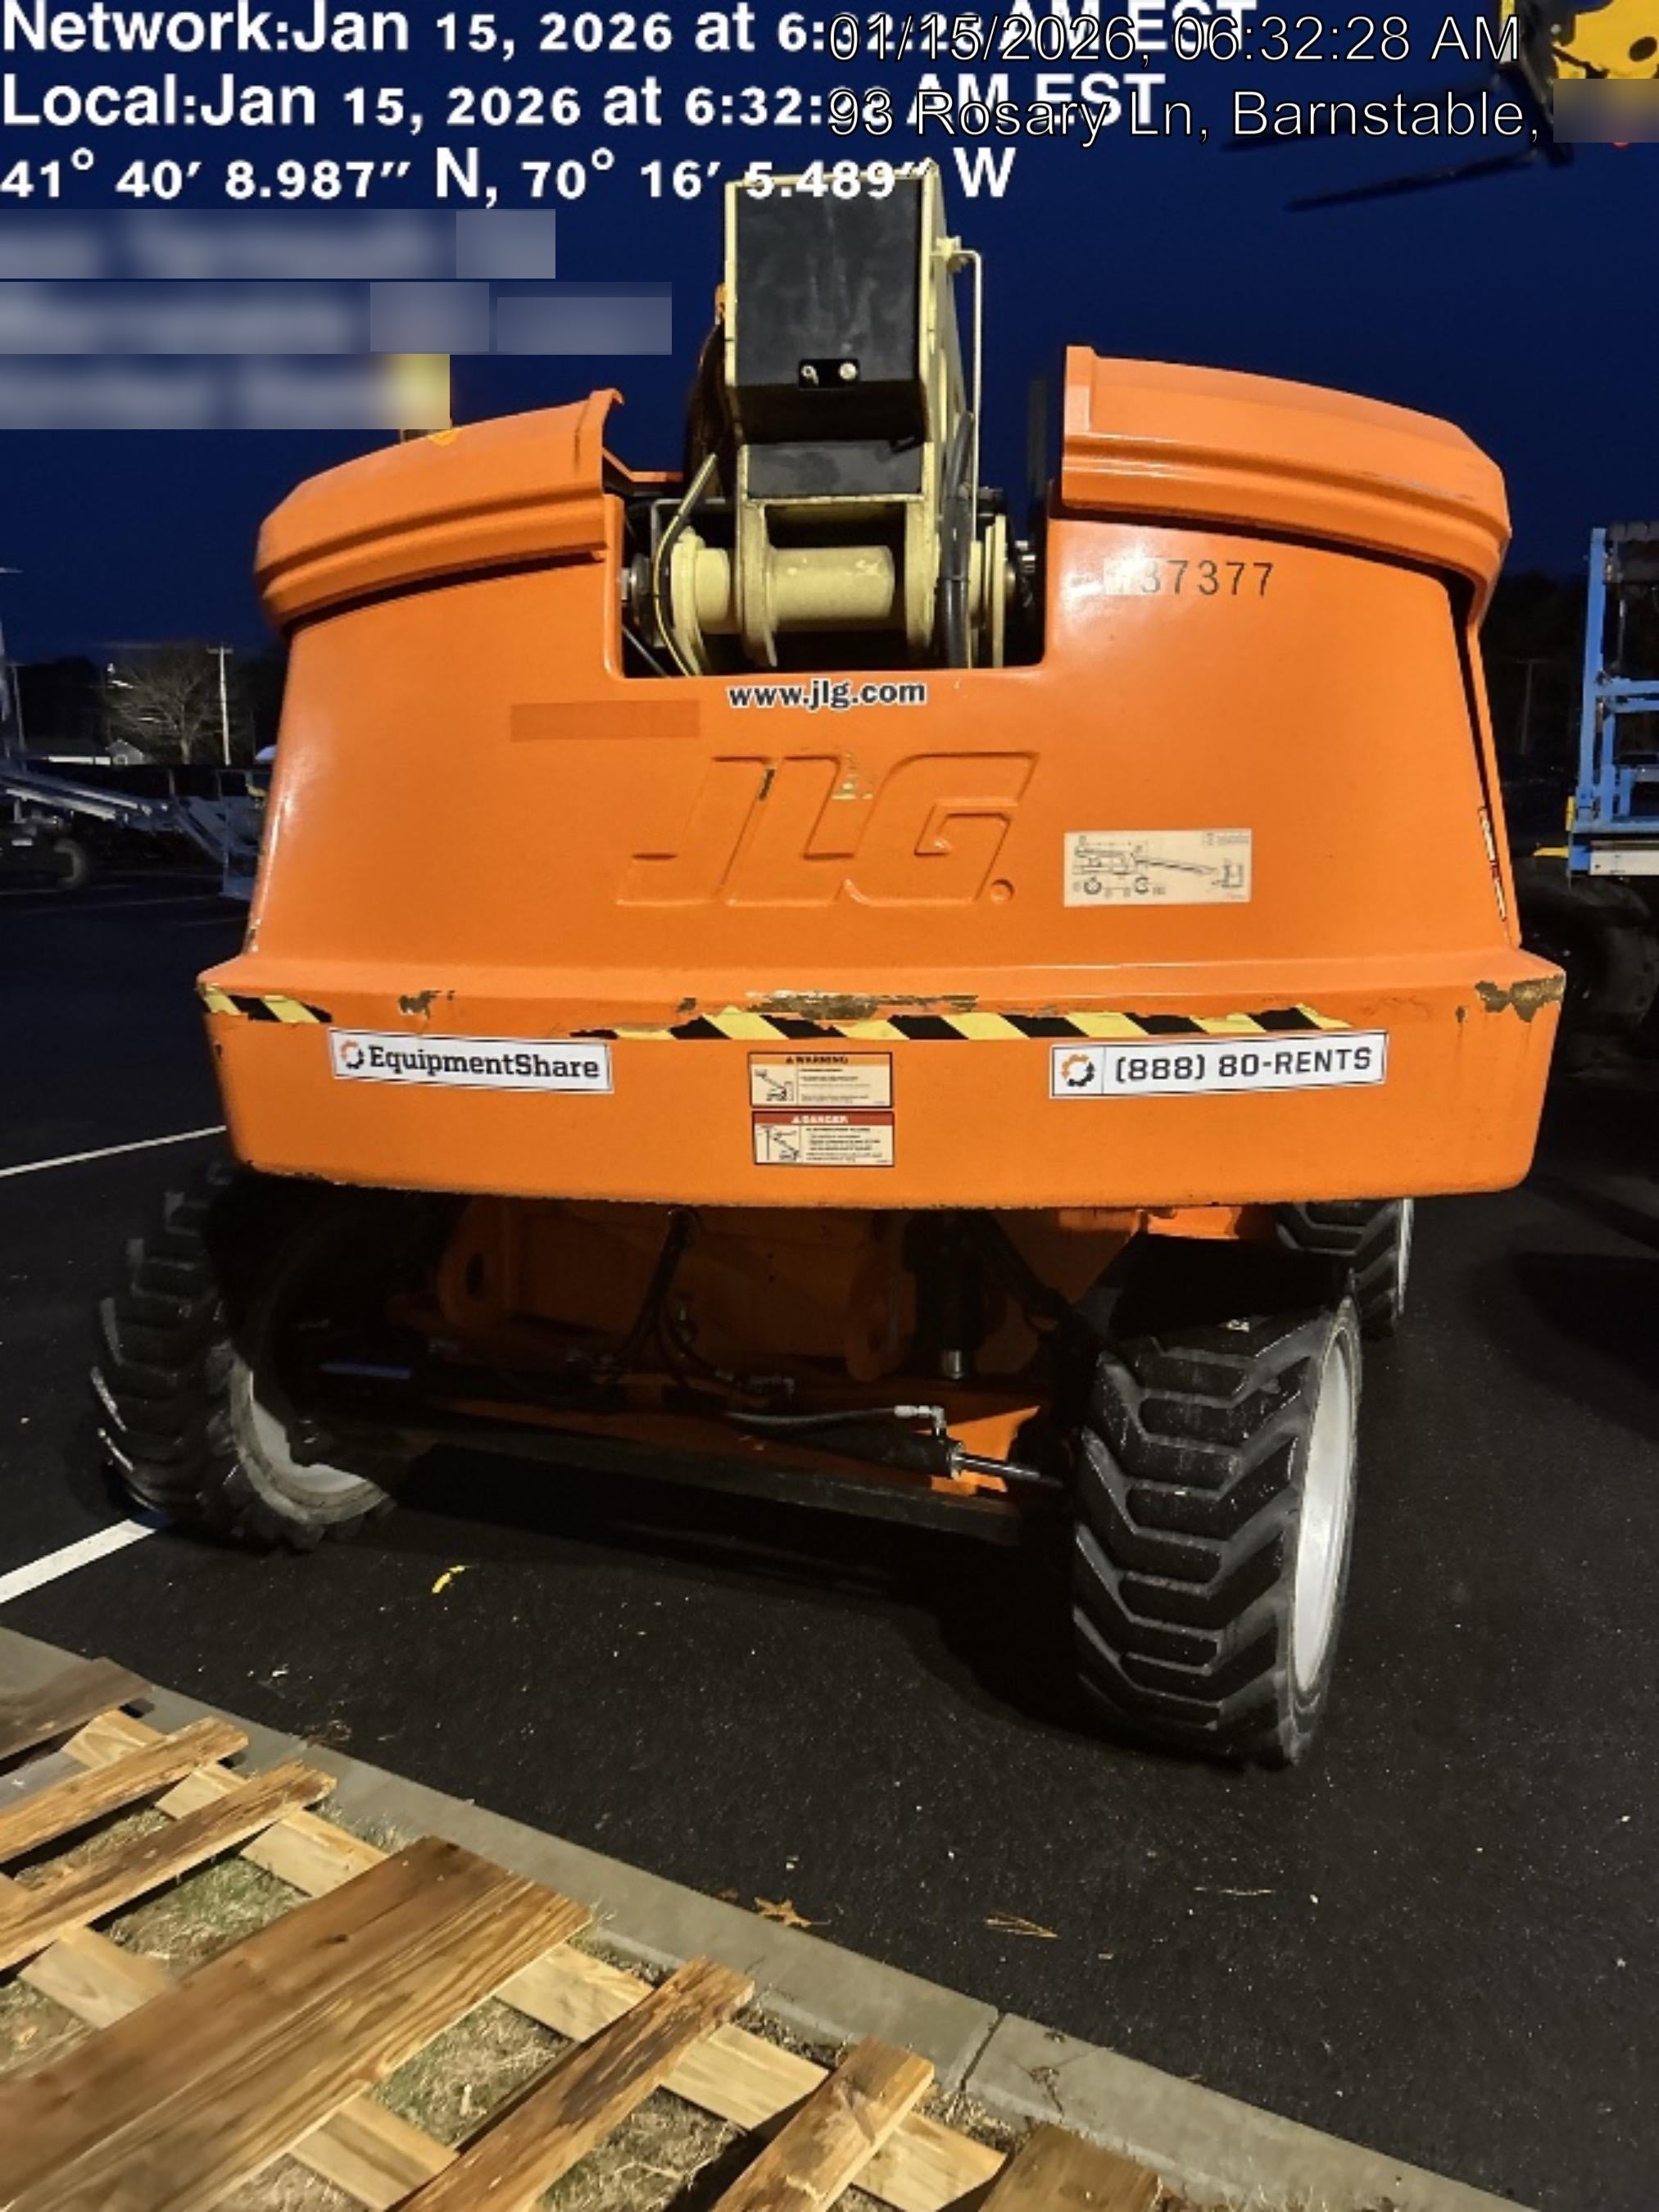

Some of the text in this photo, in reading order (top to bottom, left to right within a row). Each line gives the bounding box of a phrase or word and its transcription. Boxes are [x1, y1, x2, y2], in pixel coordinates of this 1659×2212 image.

[728, 679, 926, 710] www.jlg.com
[369, 1045, 601, 1078] EquipmentShare
[796, 1055, 849, 1065] WARNING
[1115, 1046, 1373, 1082] (888) 80-RENTS
